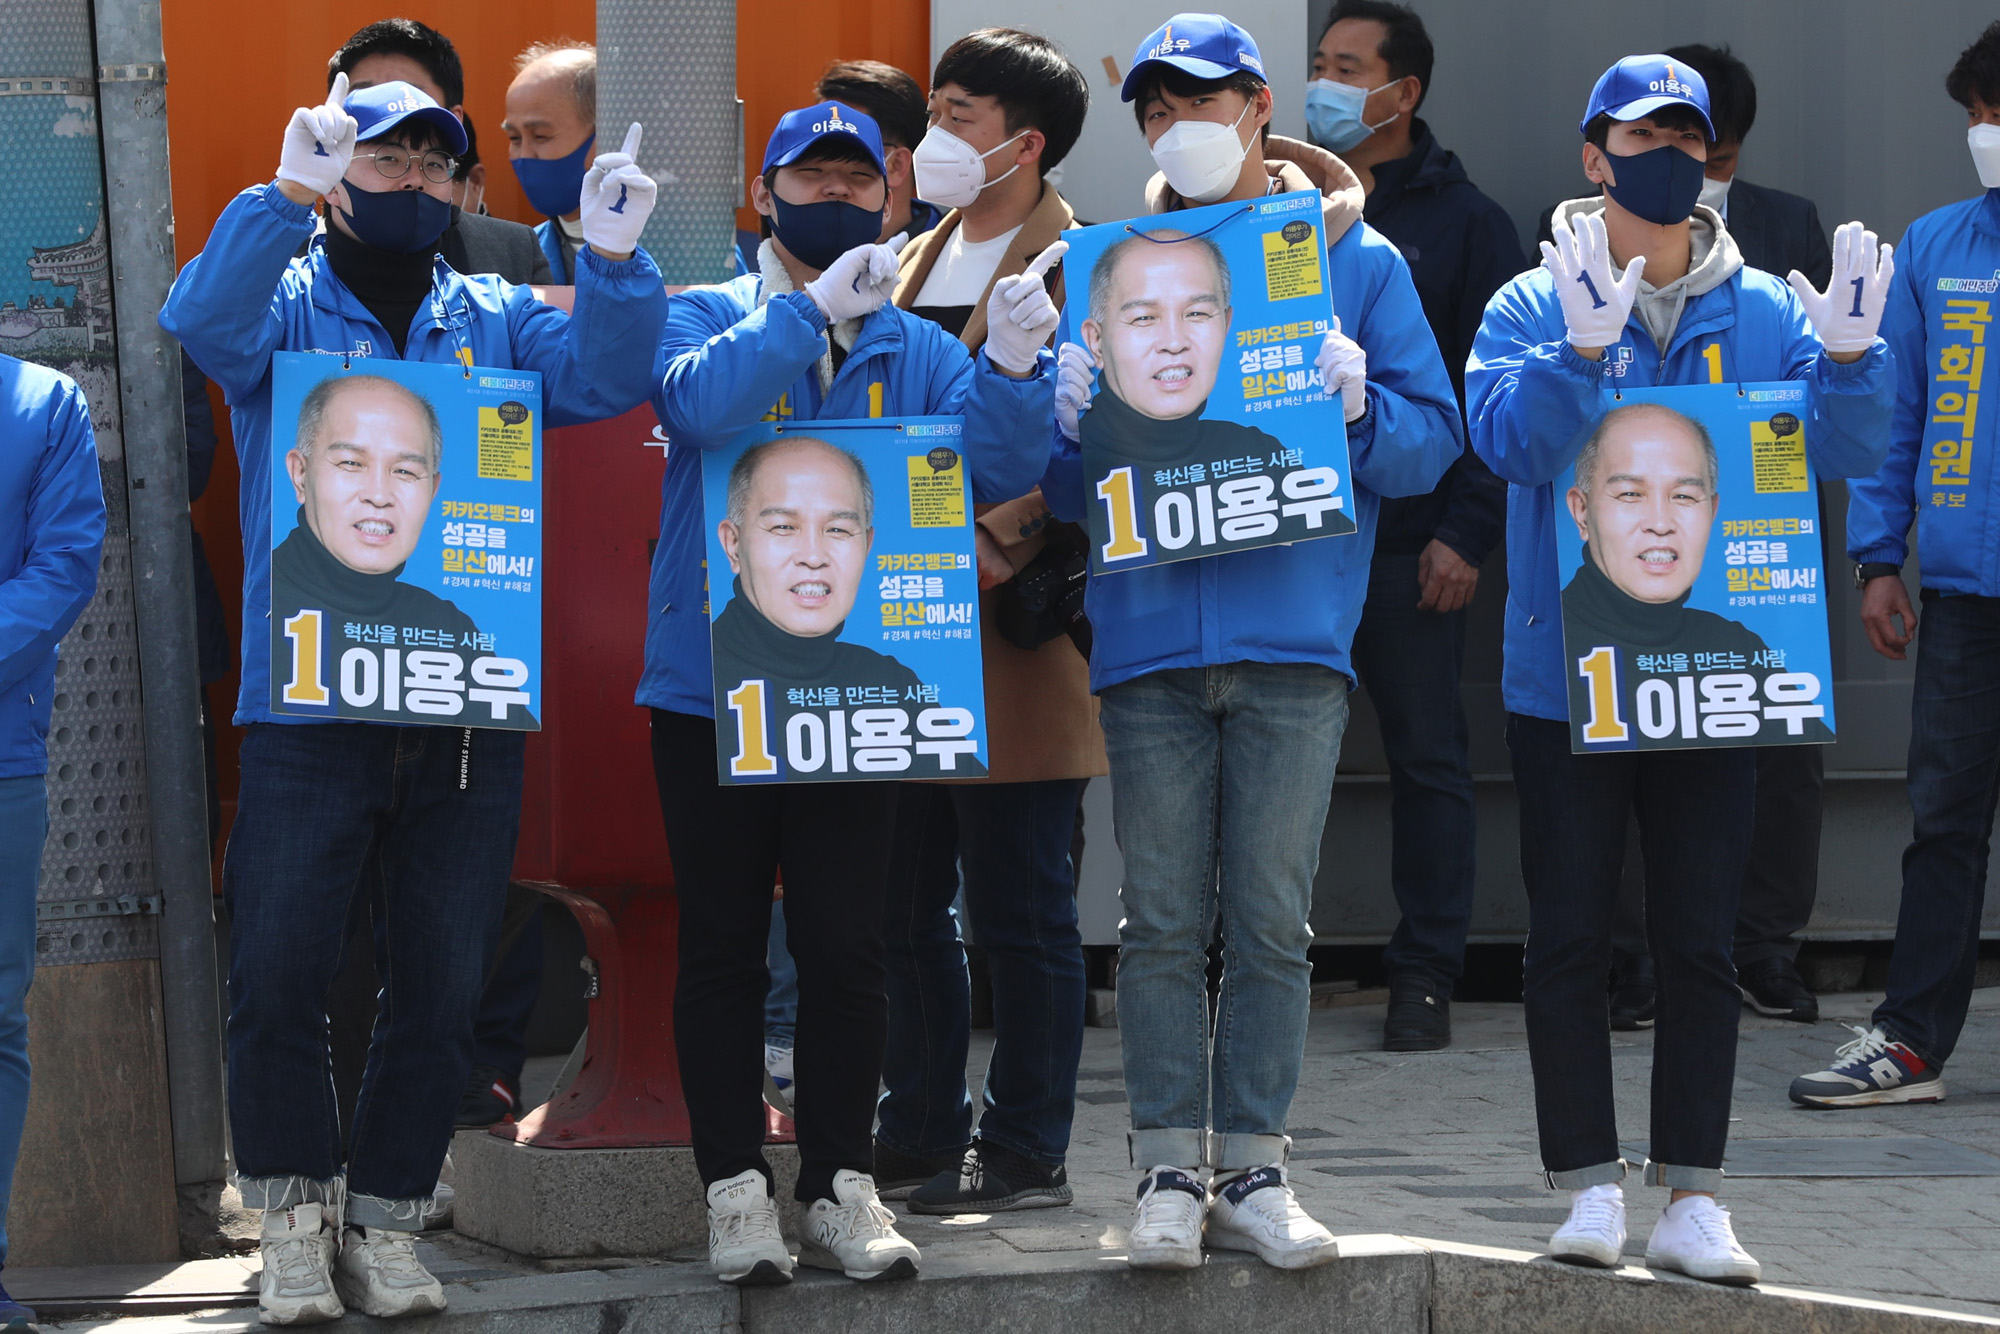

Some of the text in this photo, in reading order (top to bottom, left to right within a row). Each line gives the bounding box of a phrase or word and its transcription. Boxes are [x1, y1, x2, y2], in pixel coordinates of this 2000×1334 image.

[1164, 25, 1172, 41] 1
[1148, 39, 1191, 58] 이용우
[1665, 63, 1676, 79] 1
[400, 86, 413, 99] 1
[1650, 79, 1693, 97] 이용우
[829, 106, 840, 120] 1
[812, 119, 858, 134] 이용우
[608, 183, 627, 214] 1
[1260, 196, 1315, 214] 더불어민주당
[1576, 269, 1607, 310] 1
[1848, 276, 1865, 317] 1
[1937, 278, 1998, 293] 더불어민주당
[1236, 319, 1329, 347] 카카오뱅크의
[1239, 345, 1303, 374] 성공을
[1702, 343, 1723, 384] 1
[479, 376, 534, 391] 더불어민주당
[1748, 389, 1804, 402] 더불어민주당
[1930, 299, 1993, 485] 국회의원
[1245, 401, 1272, 413] #경제
[1275, 395, 1302, 408] #혁신
[907, 424, 961, 436] 더불어민주당
[1153, 447, 1304, 487] 혁신을 만드는 사람
[441, 500, 534, 523] 카카오뱅크의
[1154, 466, 1343, 550] 이용우
[1931, 492, 1966, 508] 후보
[1096, 466, 1148, 563] 1
[442, 522, 506, 548] 성공을
[1722, 518, 1814, 537] 카카오뱅크의
[442, 548, 534, 577] 일산에서!
[877, 553, 970, 571] 카카오뱅크의
[1724, 540, 1788, 565] 성공을
[442, 576, 531, 592] #경제 #혁신 #해결
[879, 575, 944, 599] 성공을
[1726, 567, 1817, 592] 일산에서!
[1729, 593, 1816, 607] #경제 #혁신 #해결
[880, 602, 972, 626] 일산에서!
[343, 622, 496, 651] 혁신을 만드는 사람
[883, 628, 972, 641] #경제 #혁신 #해결
[283, 609, 329, 706] 1
[1636, 649, 1786, 674] 혁신을 만드는 사람
[340, 647, 530, 720] 이용우
[786, 684, 940, 707] 혁신을 만드는 사람
[1578, 646, 1629, 743] 1
[1636, 672, 1824, 739] 이용우
[727, 679, 777, 776] 1
[785, 707, 978, 773] 이용우
[459, 749, 469, 790] STANDARD
[714, 1177, 755, 1199] new balance
[1247, 1172, 1268, 1187] FILA
[728, 1187, 747, 1199] 878
[815, 1221, 838, 1249] N
